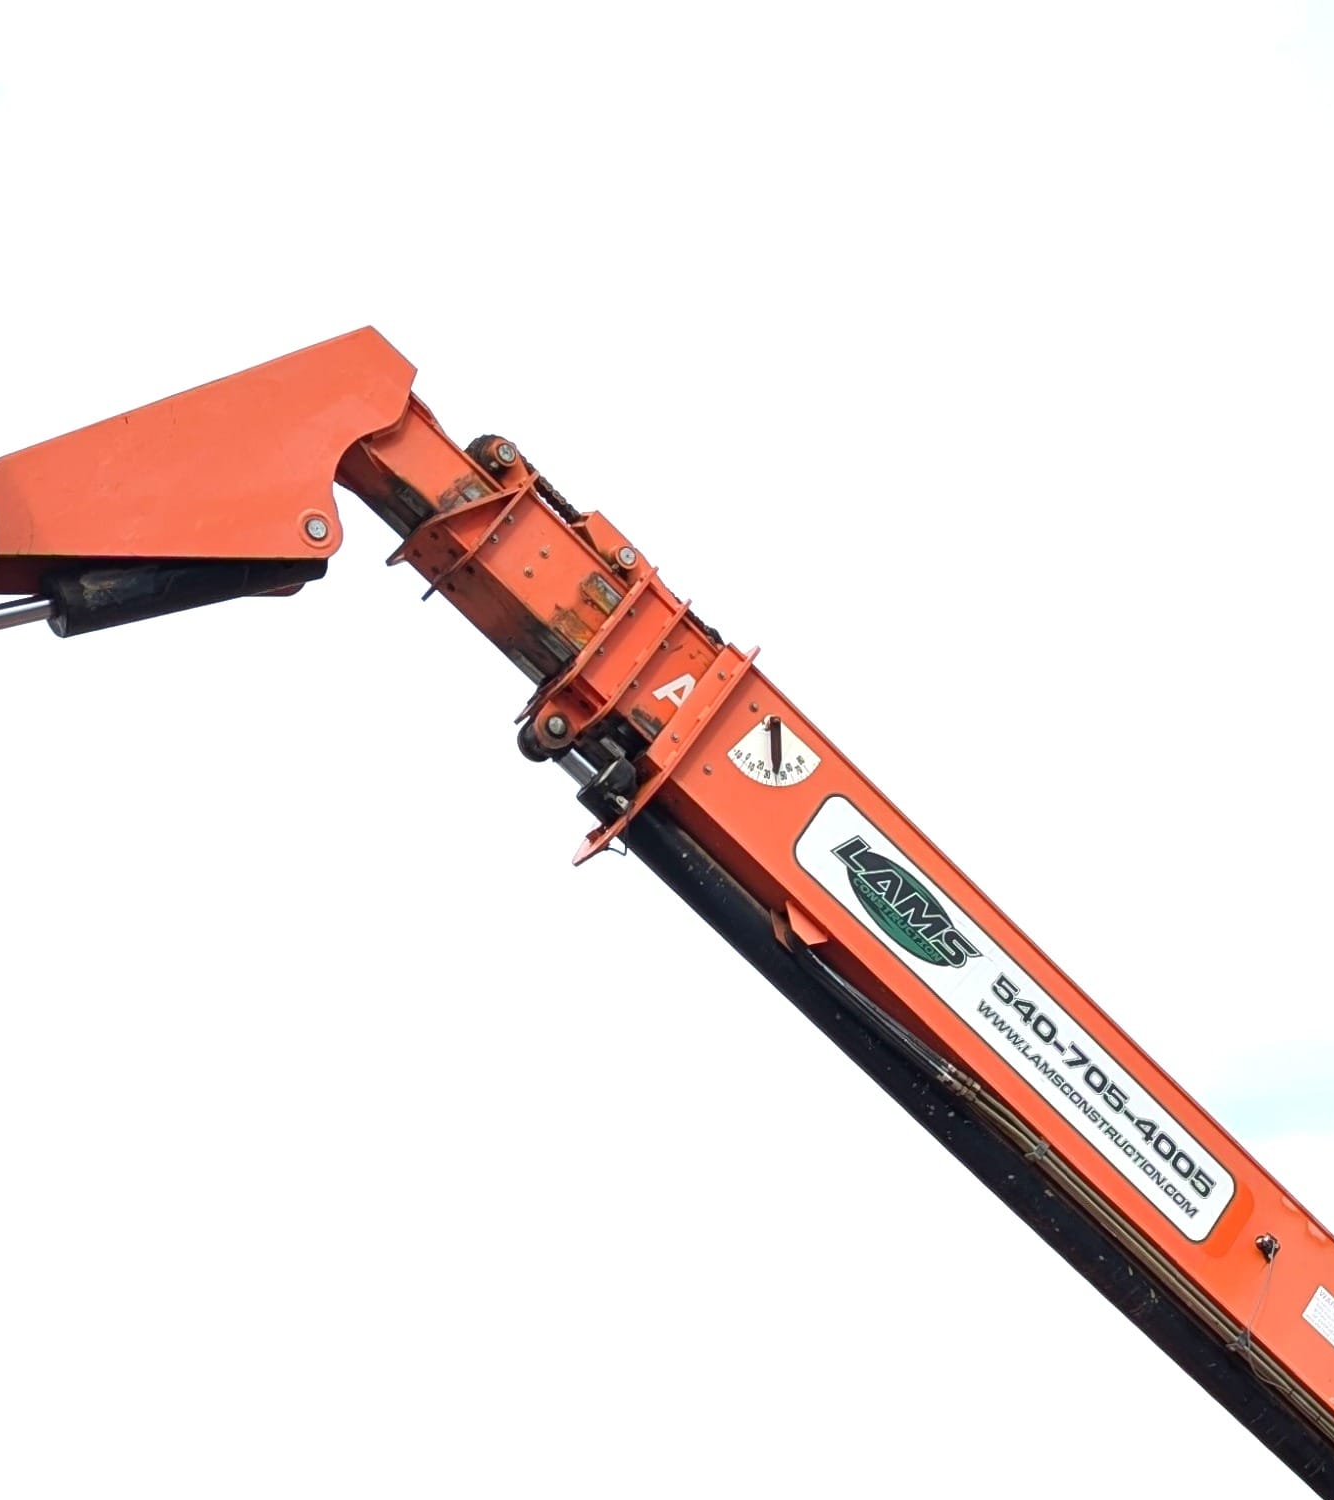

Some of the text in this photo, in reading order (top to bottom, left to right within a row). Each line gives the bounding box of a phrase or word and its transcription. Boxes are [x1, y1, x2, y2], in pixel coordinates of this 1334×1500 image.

[652, 673, 697, 708] A
[830, 835, 983, 968] LAMS
[852, 876, 943, 963] CONSTRUCTION
[976, 998, 1199, 1220] WWW.LAMSCONSTRUCTION.COM
[990, 972, 1217, 1199] 540-705-4005
